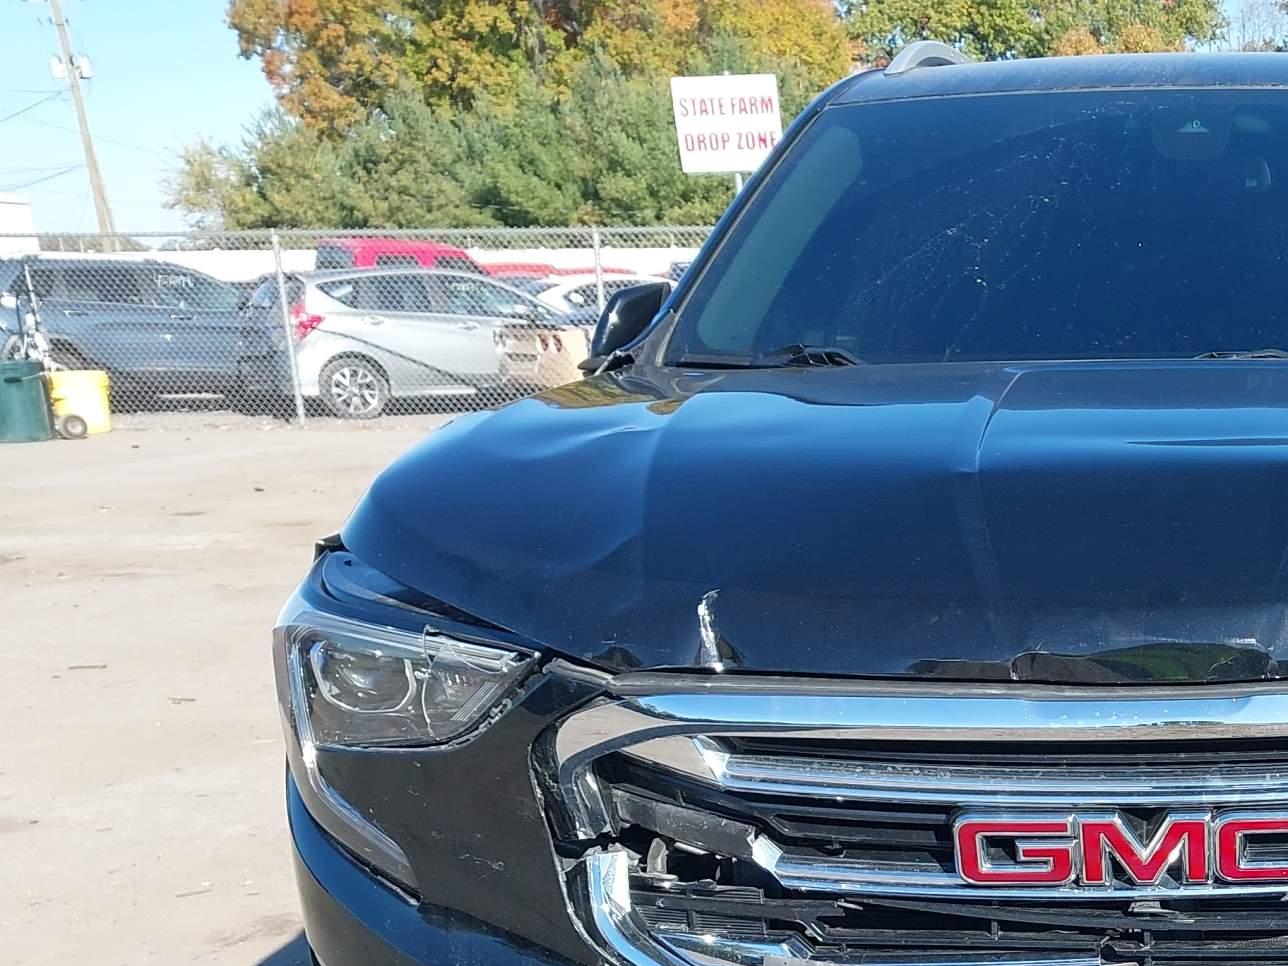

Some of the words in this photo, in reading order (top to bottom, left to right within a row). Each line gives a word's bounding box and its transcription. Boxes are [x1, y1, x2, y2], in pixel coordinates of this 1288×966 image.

[679, 97, 727, 117] STATE
[731, 96, 774, 115] FARM
[684, 132, 730, 152] DROP
[736, 131, 777, 150] ZONE
